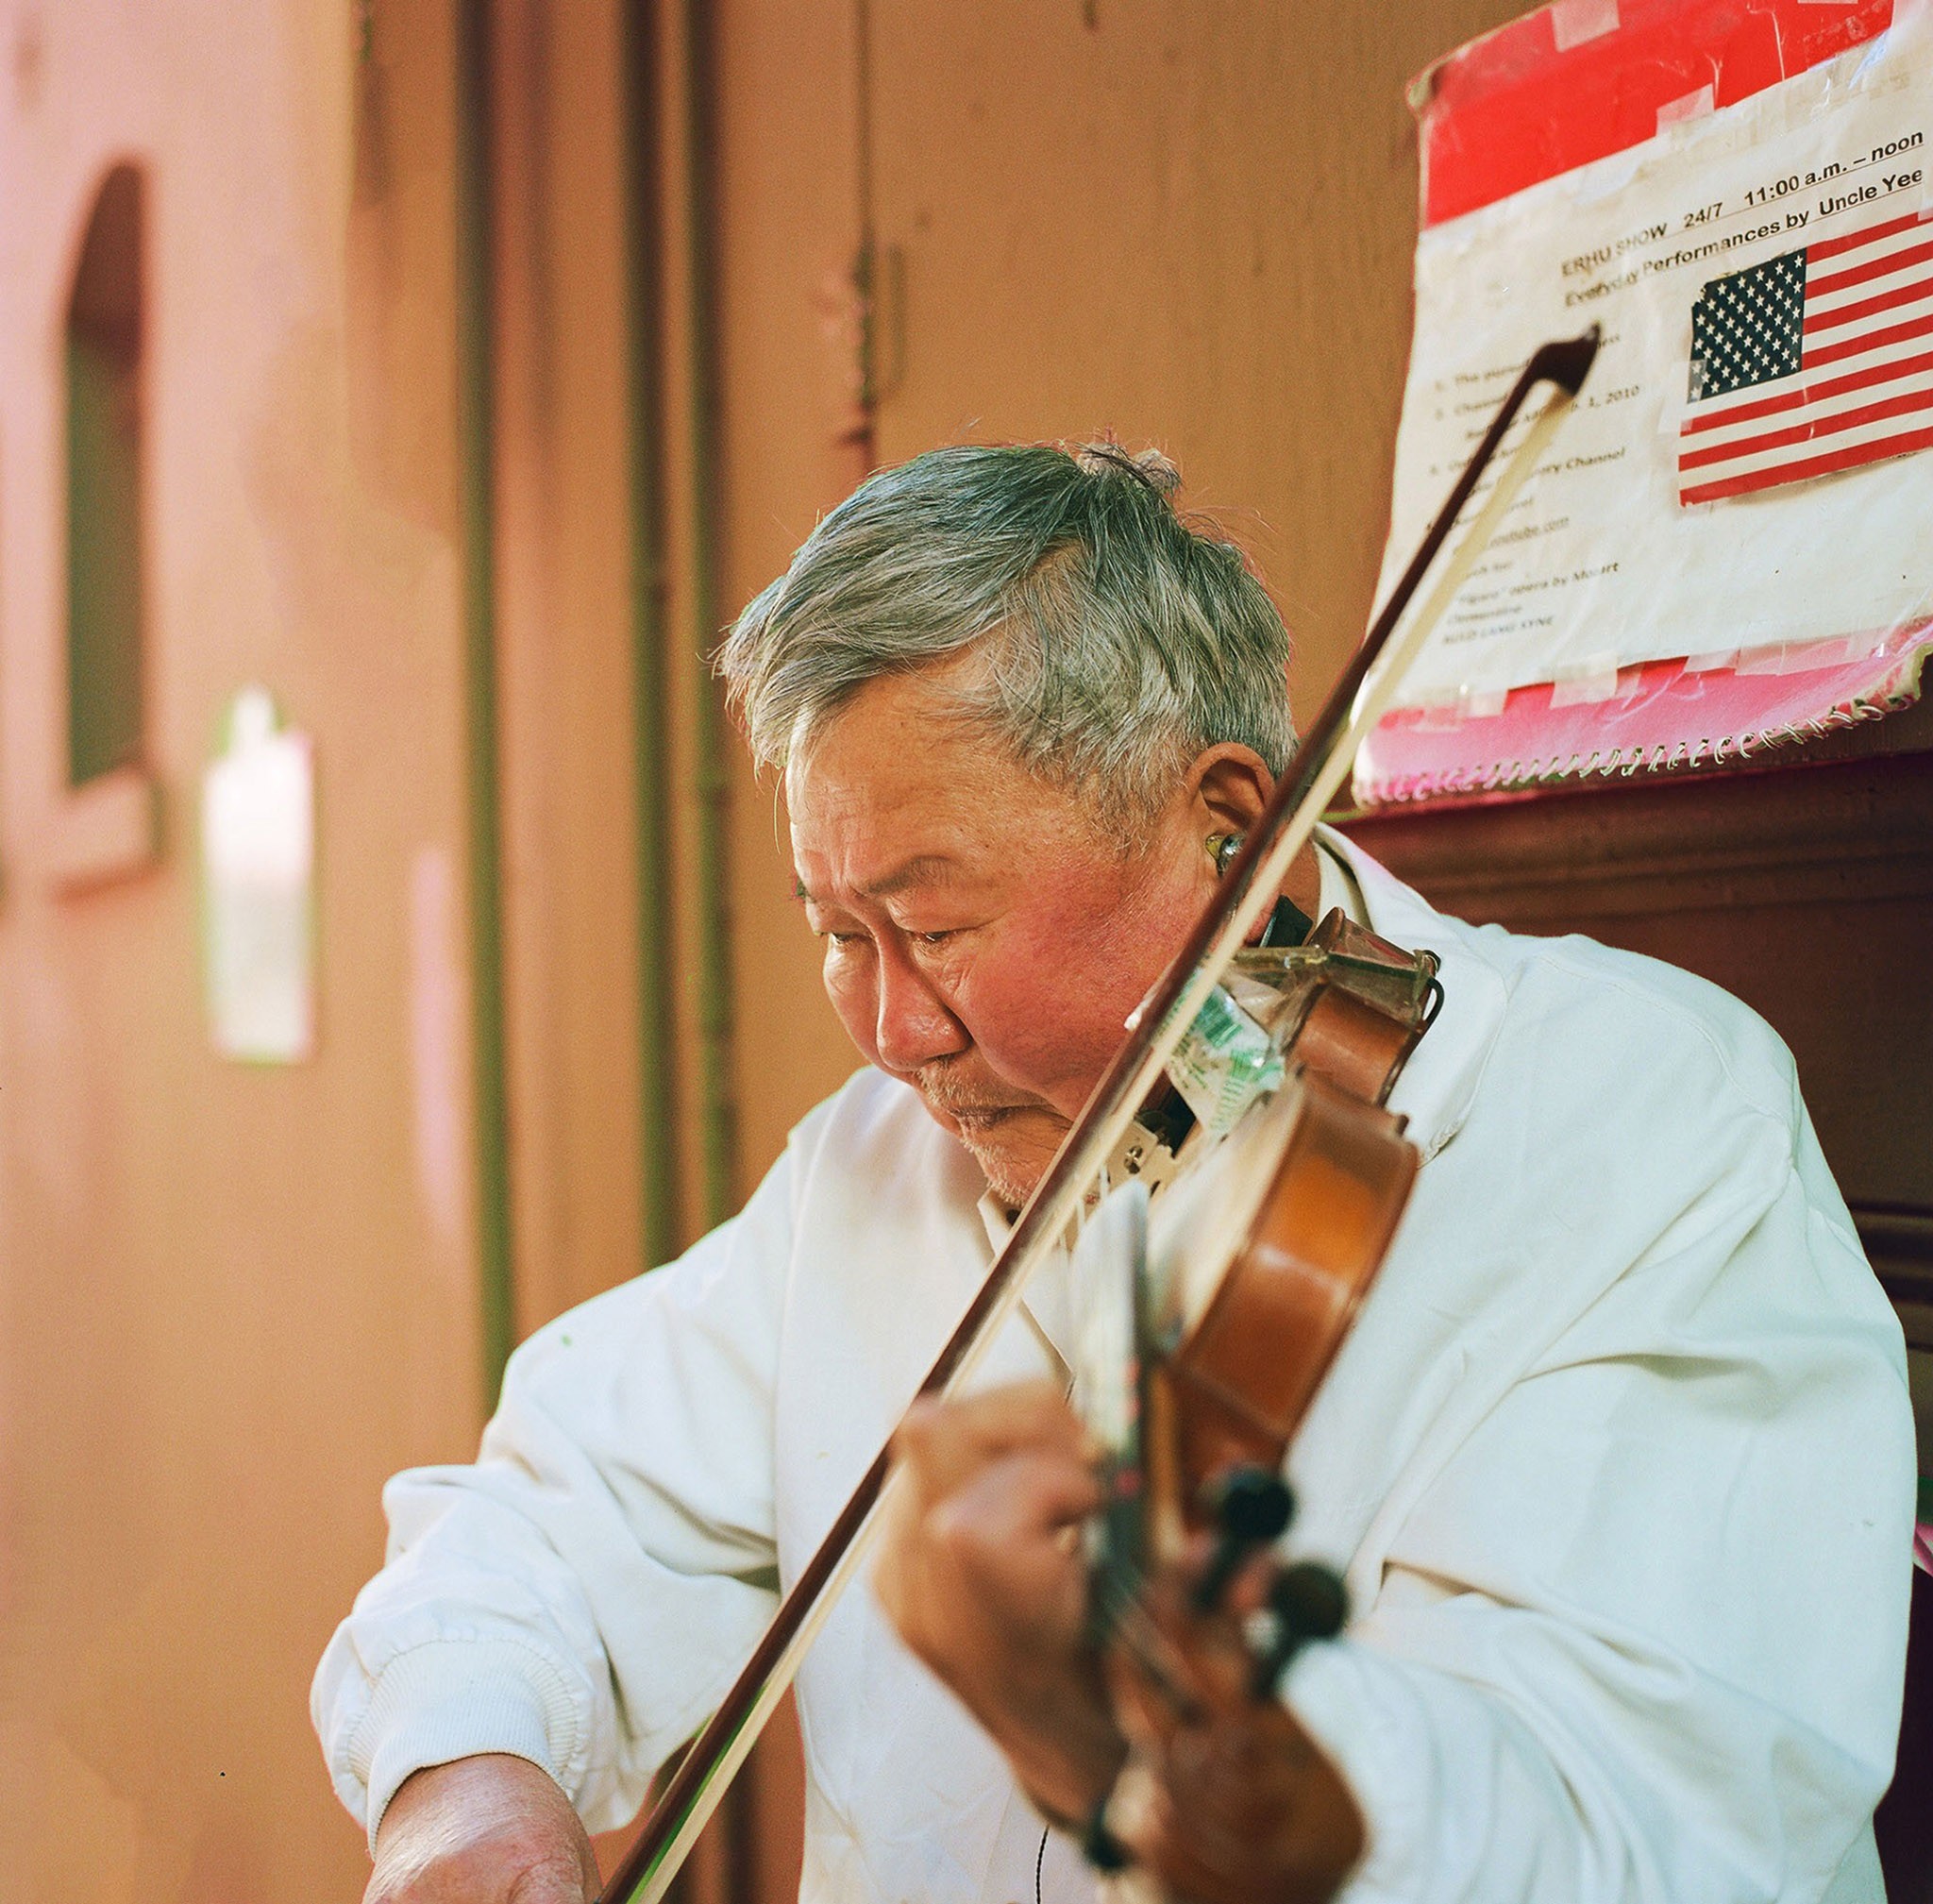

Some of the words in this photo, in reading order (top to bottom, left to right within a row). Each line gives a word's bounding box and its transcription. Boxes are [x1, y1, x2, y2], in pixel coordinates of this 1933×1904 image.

[1561, 245, 1612, 278] ERHU
[1615, 222, 1668, 256] SHOW
[1683, 201, 1723, 228] 24/7
[1743, 175, 1800, 207] 11:00
[1804, 161, 1847, 186] a.m.
[1871, 130, 1925, 162] noon
[1642, 220, 1781, 277] Performances
[1785, 210, 1809, 229] by
[1818, 184, 1878, 217] Uncle
[1881, 168, 1923, 193] Yee
[1605, 384, 1640, 405] 2010
[1565, 447, 1626, 471] Channel
